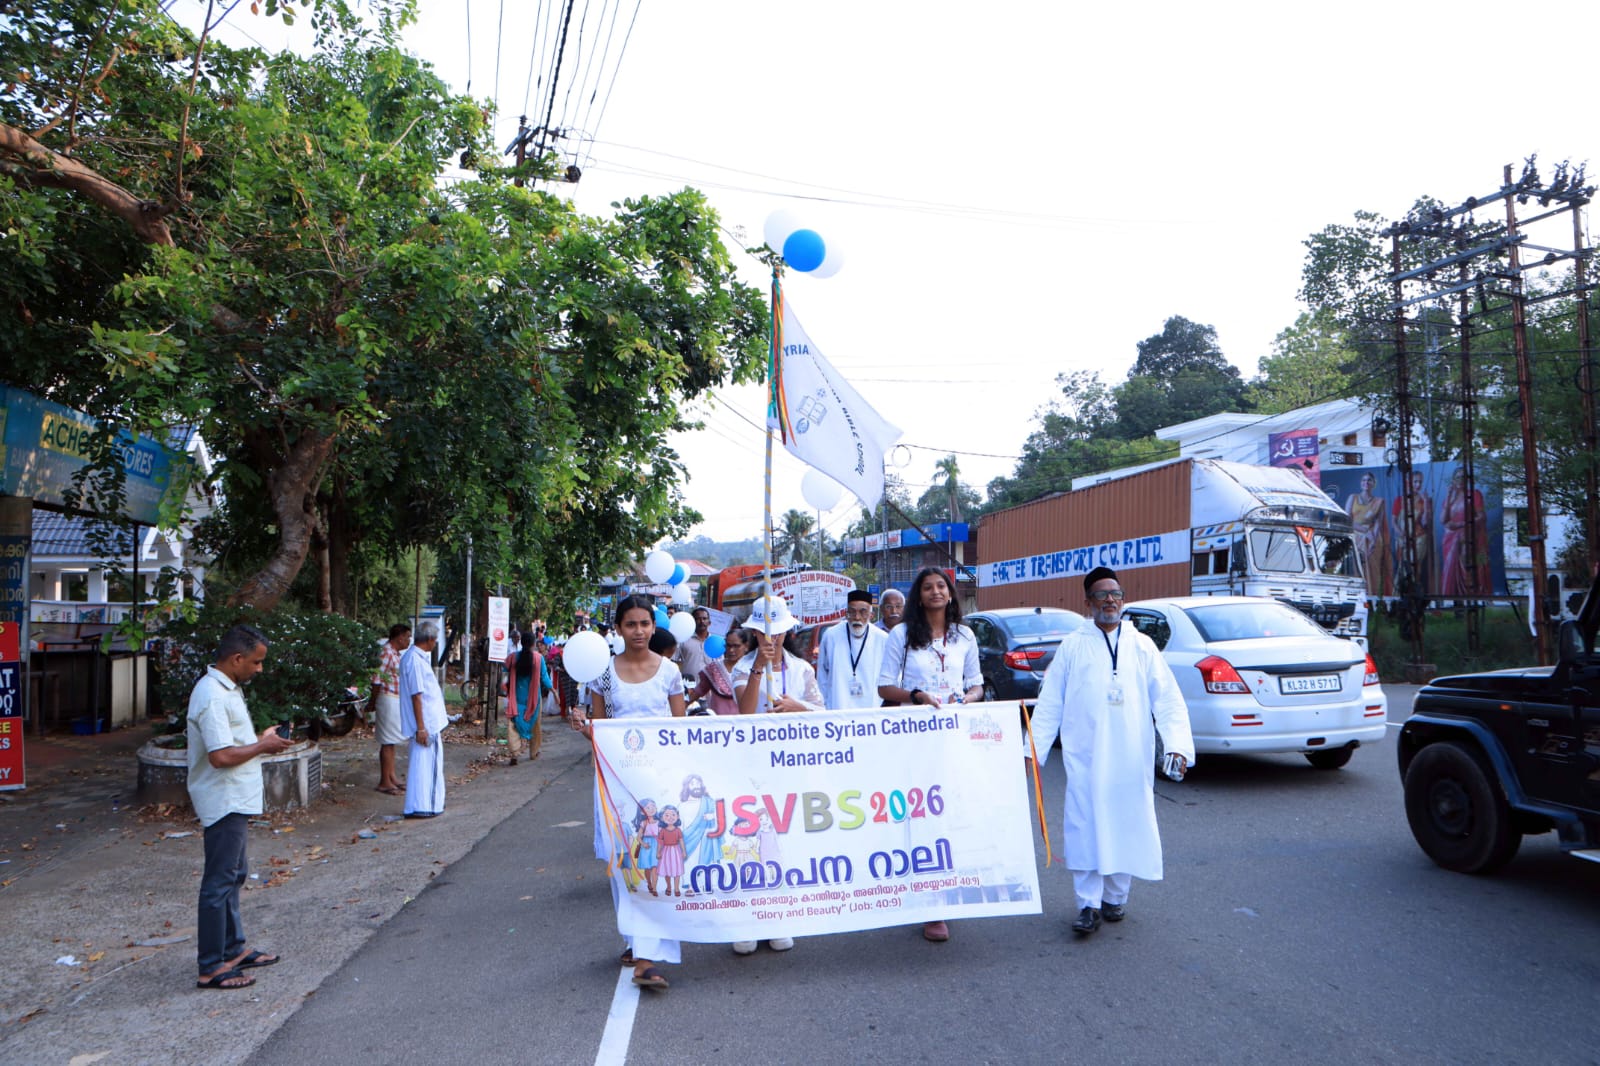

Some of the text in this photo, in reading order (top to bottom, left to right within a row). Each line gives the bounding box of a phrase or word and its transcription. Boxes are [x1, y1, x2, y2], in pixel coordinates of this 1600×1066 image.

[1031, 547, 1095, 578] TRANSPORT
[816, 572, 852, 588] PRODUCTS
[1310, 679, 1316, 689] H
[1317, 678, 1338, 690] 5717
[658, 713, 959, 748] St. Mary's Jacobite Syrian Cathedral
[770, 746, 855, 768] Manarcad
[869, 784, 945, 824] 2026
[690, 838, 954, 894] സമാപന റാലി
[786, 907, 804, 918] and
[849, 901, 873, 913] (Job:
[875, 897, 902, 909] 40:9)
